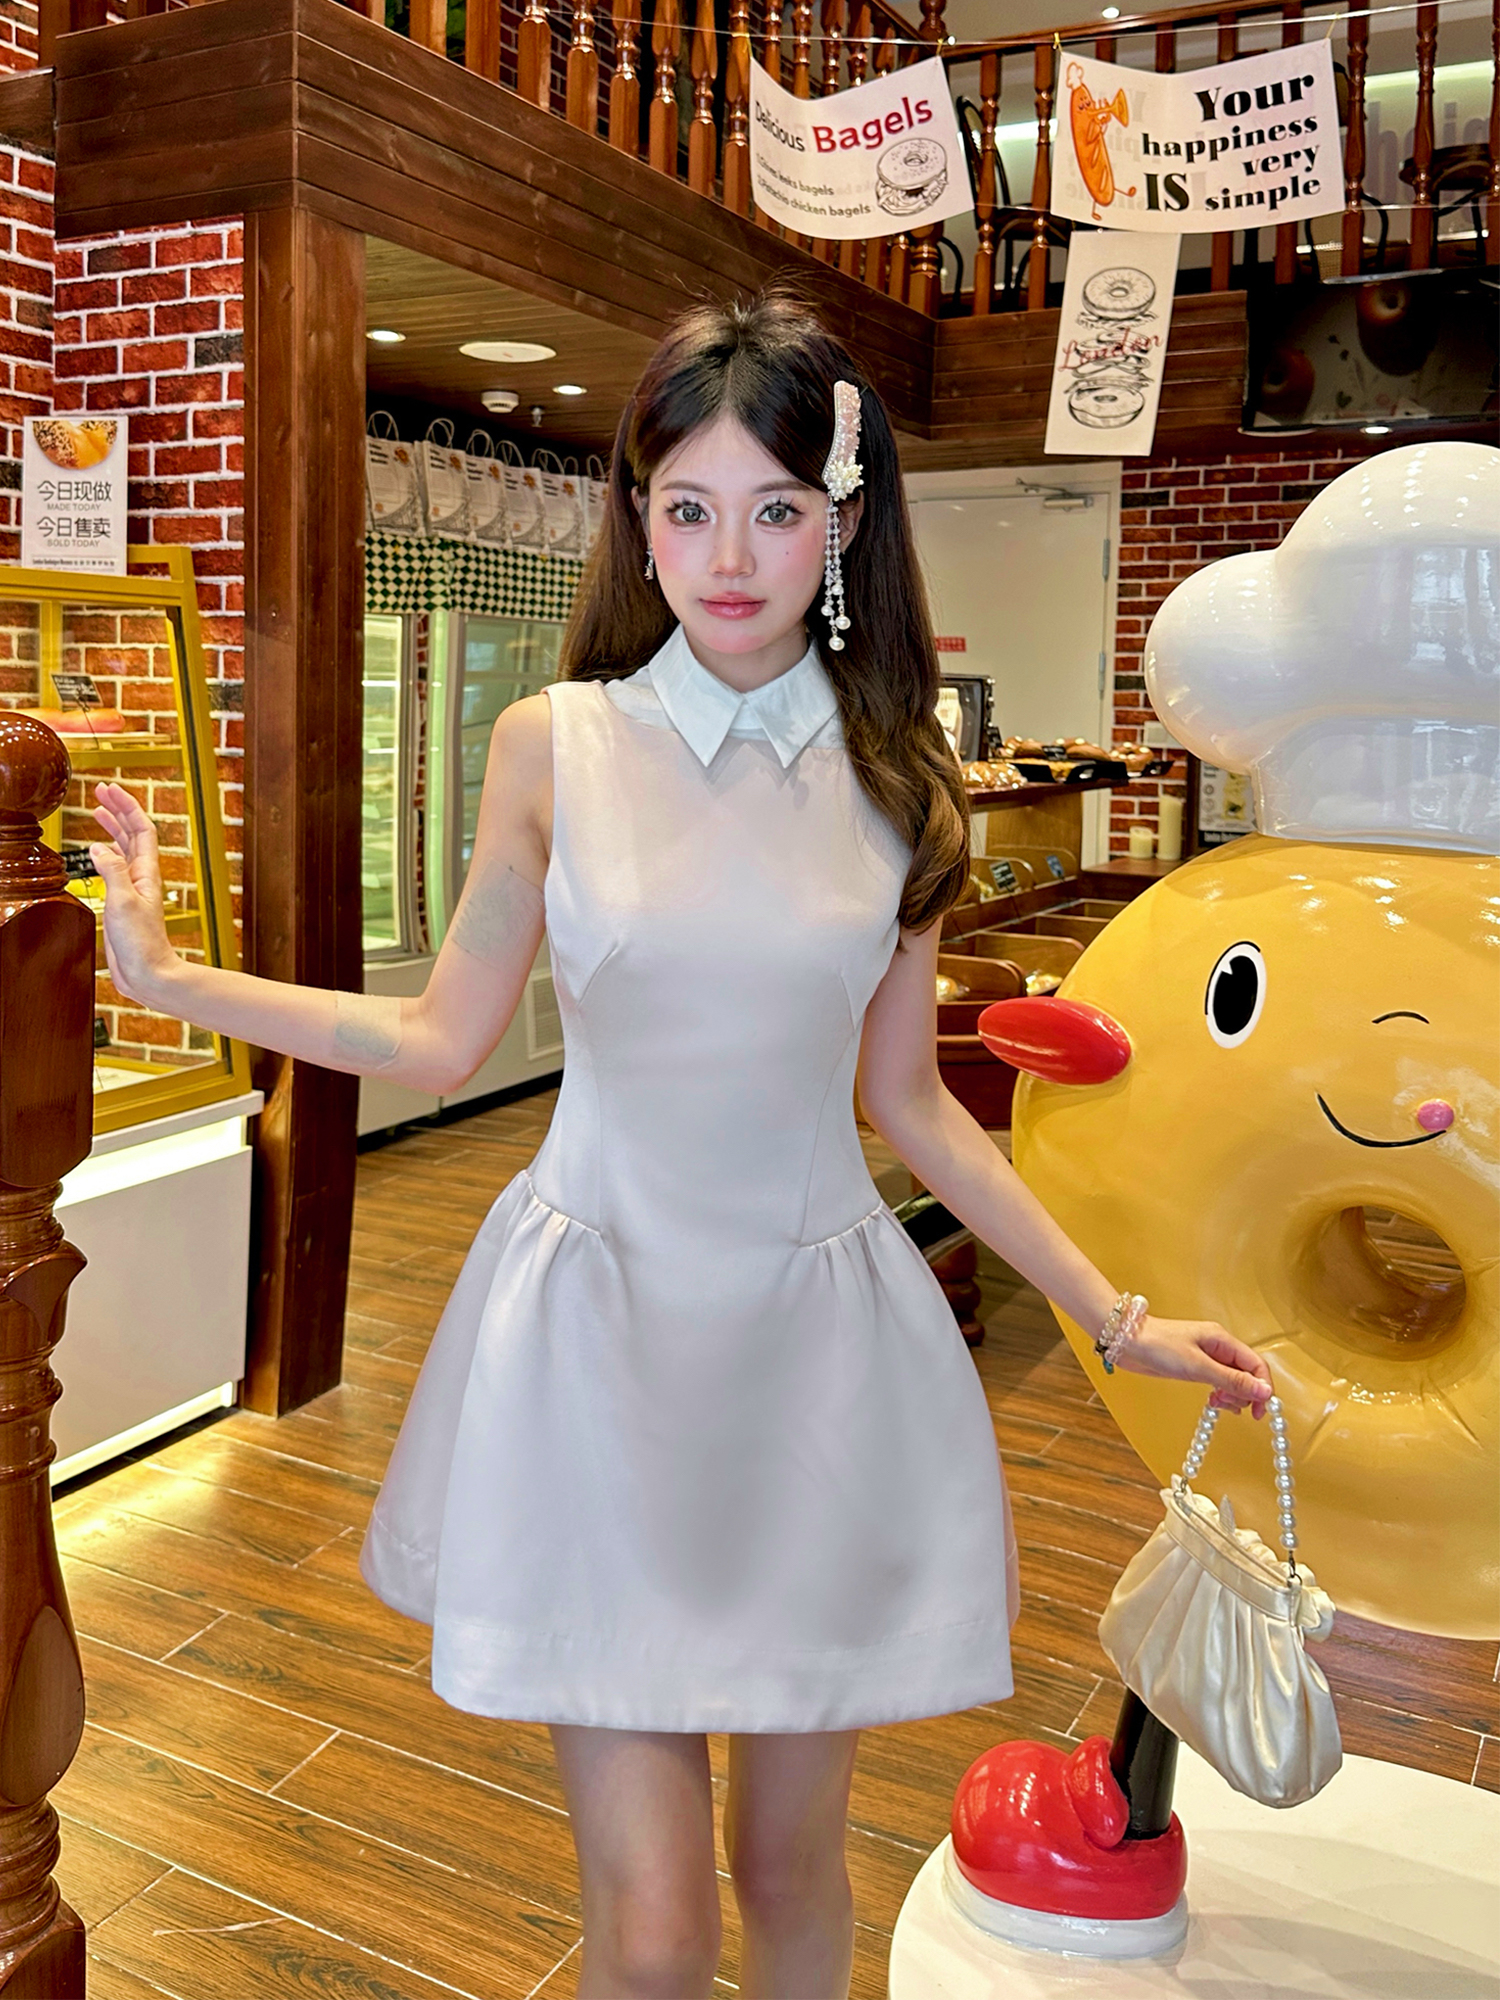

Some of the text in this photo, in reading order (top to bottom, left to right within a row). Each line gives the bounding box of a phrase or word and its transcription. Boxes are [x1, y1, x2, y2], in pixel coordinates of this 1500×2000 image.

[1194, 74, 1314, 122] Your
[755, 97, 933, 153] Delicious Bagels
[1141, 115, 1318, 164] happiness
[1242, 145, 1320, 176] very
[799, 180, 835, 196] bagels
[1143, 172, 1321, 212] IS simple
[790, 199, 827, 216] chicken
[829, 203, 871, 218] bagels
[37, 480, 112, 502] 今日现做
[47, 503, 101, 511] MADE TODAY
[37, 516, 112, 538] 今日售卖
[47, 539, 101, 547] SOLD TODAY
